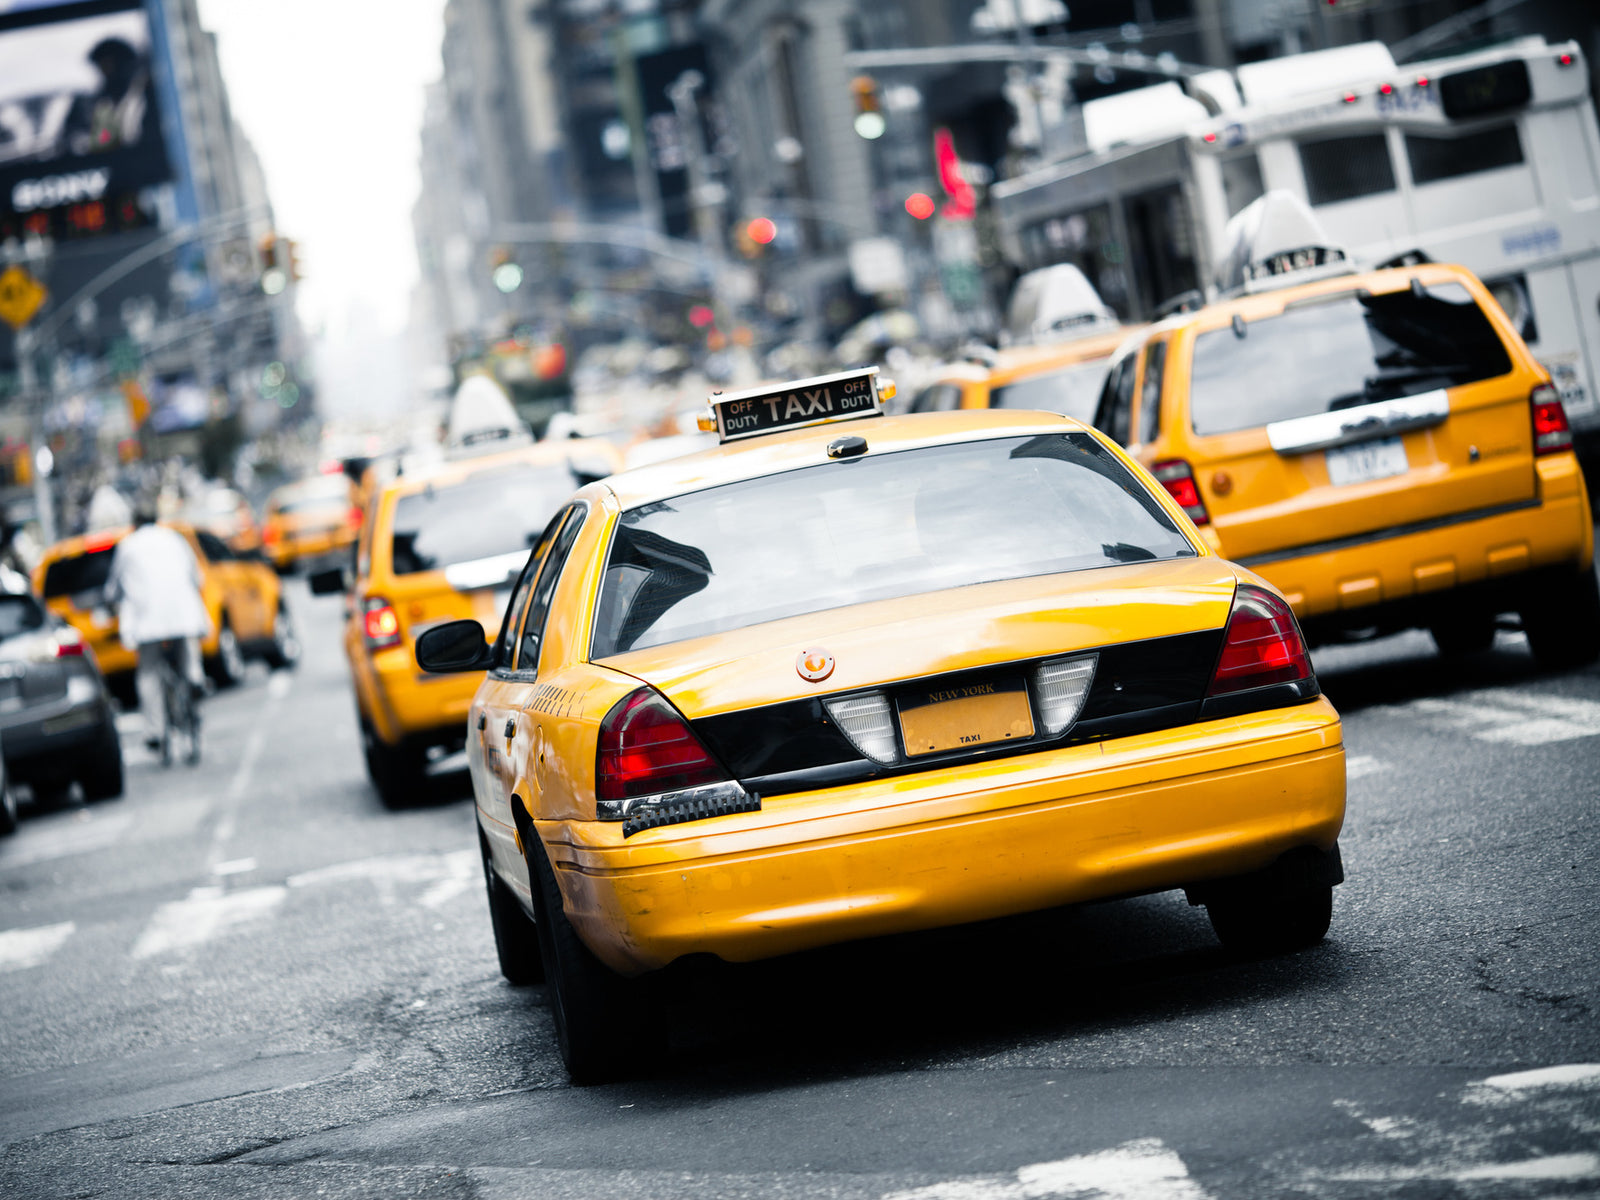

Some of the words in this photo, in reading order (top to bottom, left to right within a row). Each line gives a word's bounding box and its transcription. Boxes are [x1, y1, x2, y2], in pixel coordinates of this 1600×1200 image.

[844, 380, 867, 394] OFF
[730, 400, 753, 414] OFF
[763, 388, 833, 422] TAXI
[841, 394, 872, 409] DUTY
[726, 414, 759, 430] DUTY
[928, 689, 959, 703] NEW
[961, 682, 995, 696] YORK
[959, 734, 981, 743] TAXI
